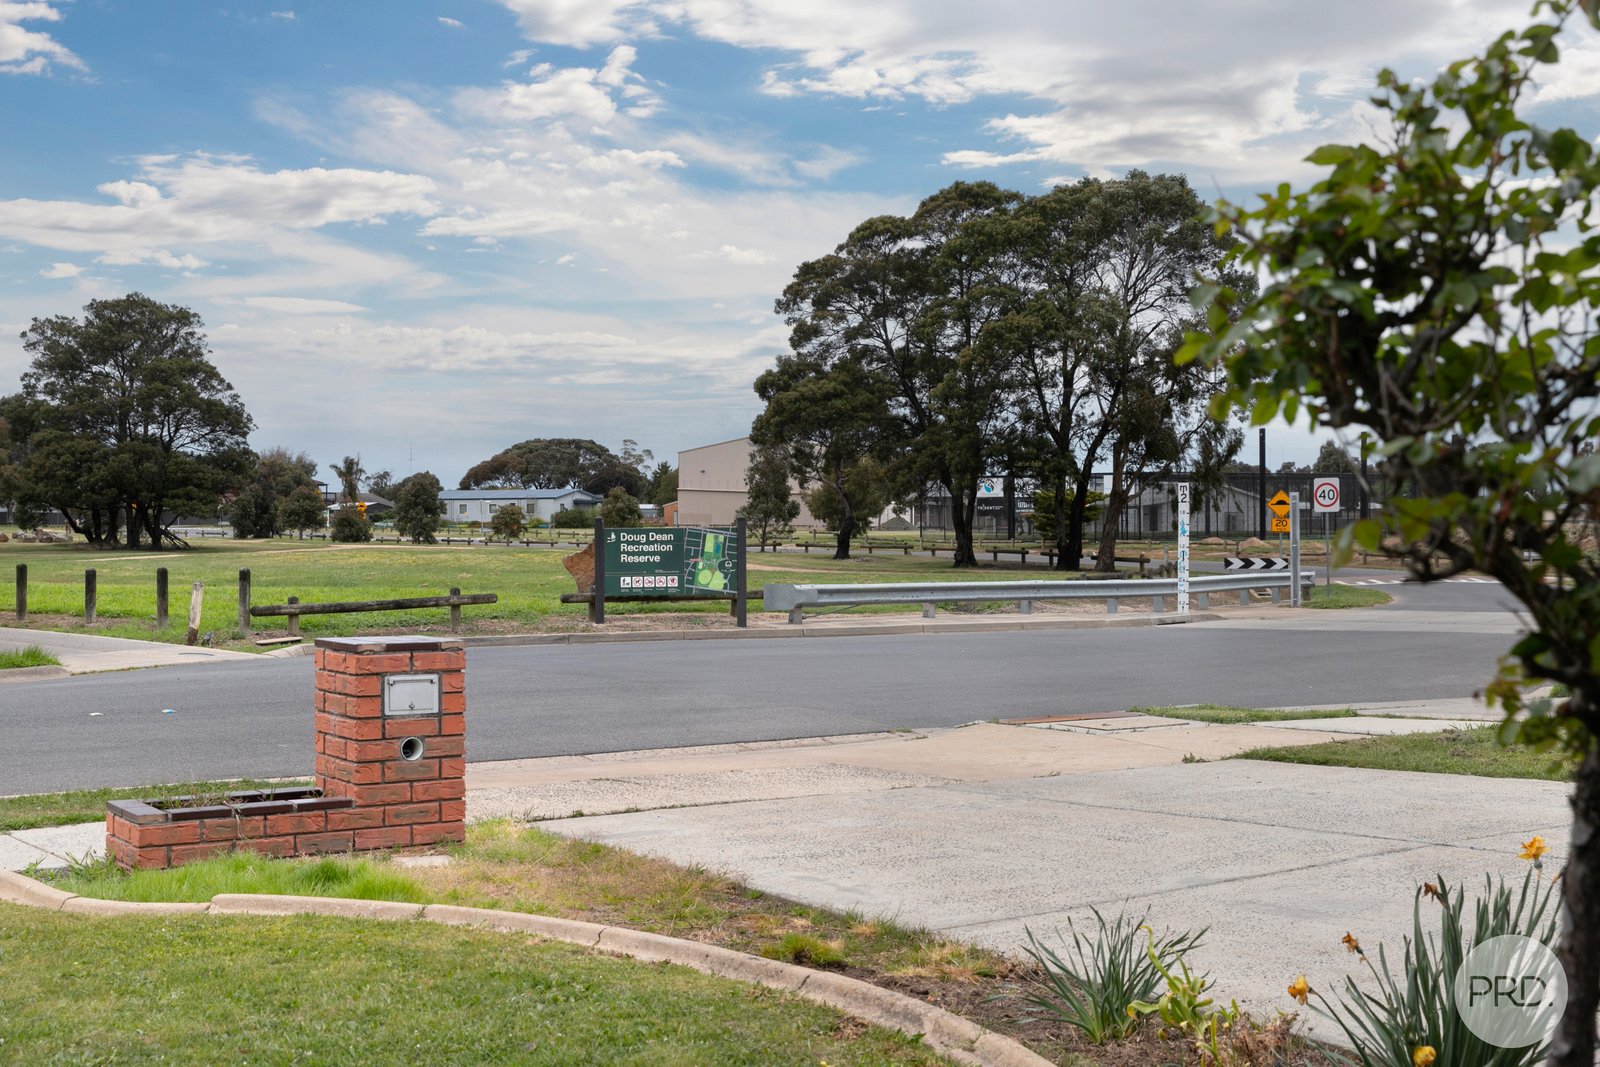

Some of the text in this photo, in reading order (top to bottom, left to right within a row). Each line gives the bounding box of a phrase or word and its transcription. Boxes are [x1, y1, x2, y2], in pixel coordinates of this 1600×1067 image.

[1181, 493, 1187, 503] 2
[1319, 489, 1335, 500] 40
[620, 532, 674, 543] Doug Dean
[620, 543, 673, 552] Recreation
[620, 554, 661, 563] Reserve
